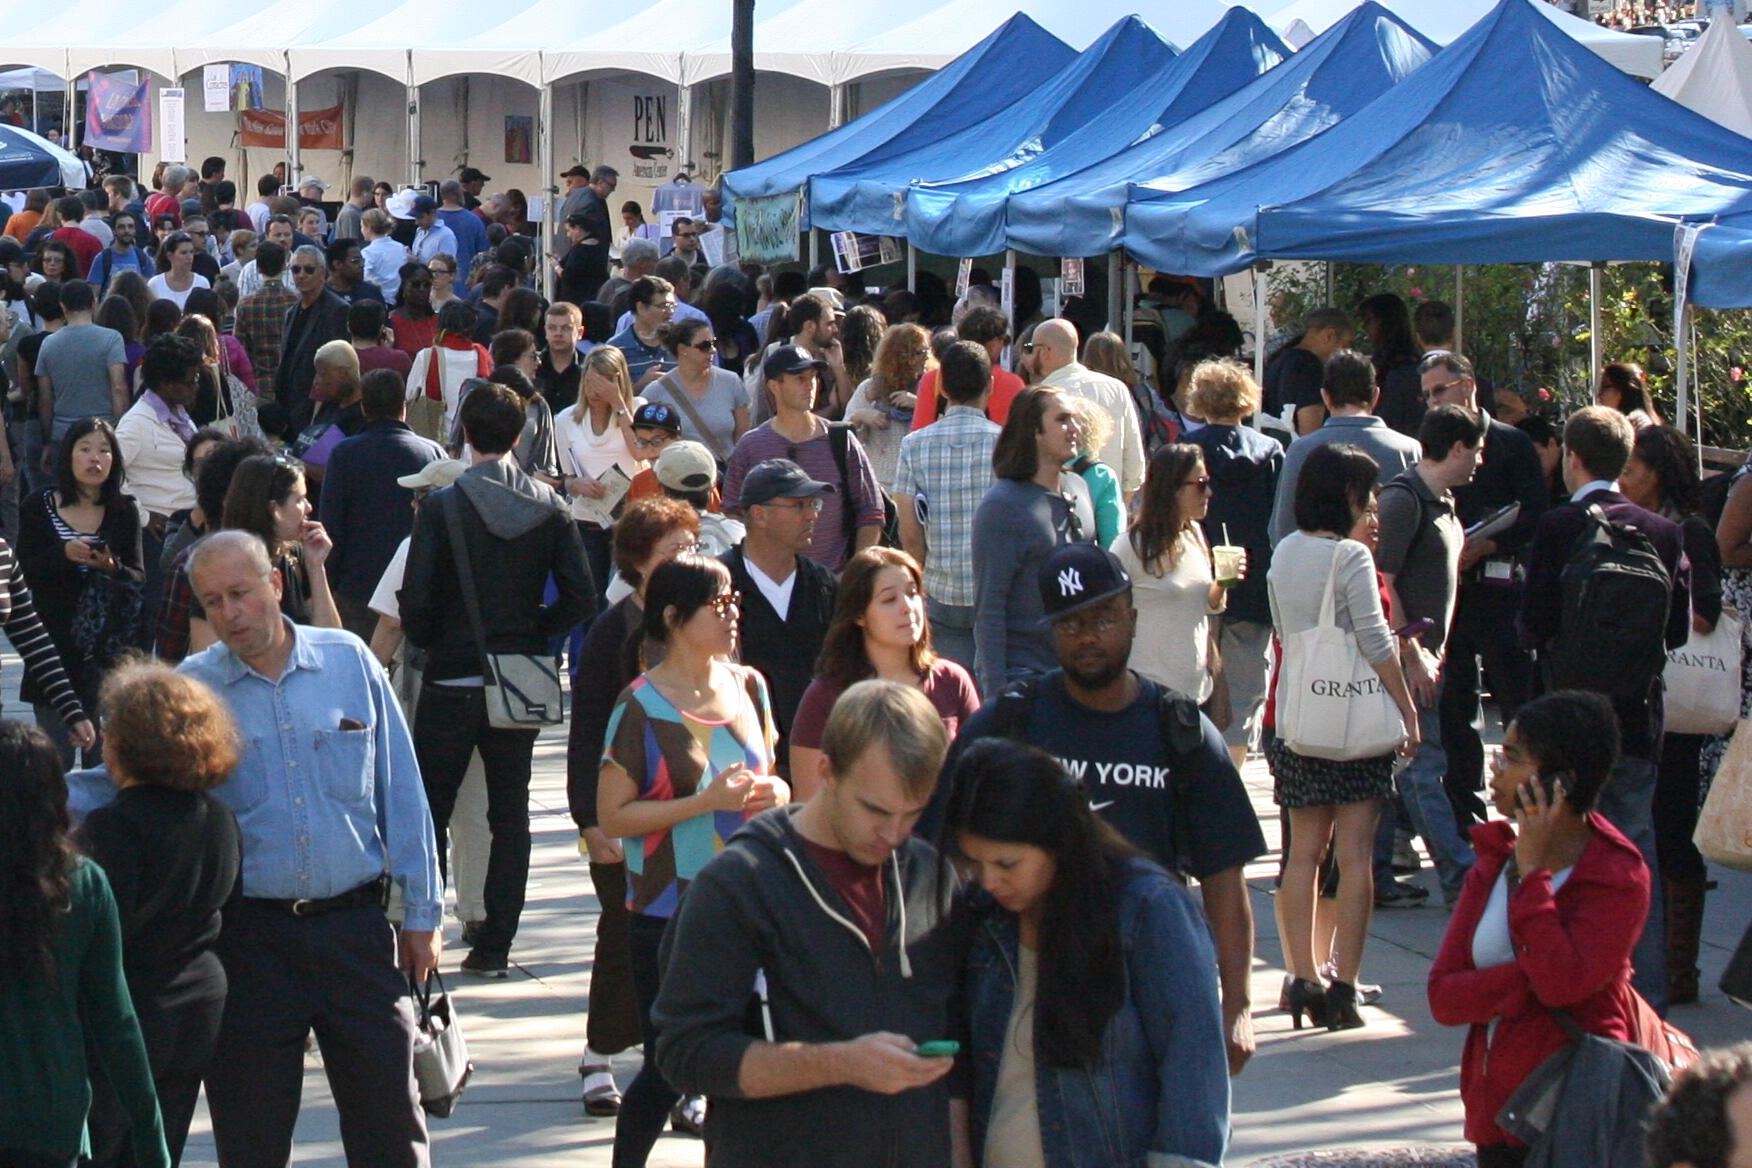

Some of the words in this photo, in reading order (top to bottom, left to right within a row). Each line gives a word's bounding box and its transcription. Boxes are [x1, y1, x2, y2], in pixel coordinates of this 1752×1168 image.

[634, 95, 666, 142] PEN
[1058, 567, 1084, 596] NY
[1667, 649, 1727, 672] RANTA
[1095, 762, 1170, 790] YORK
